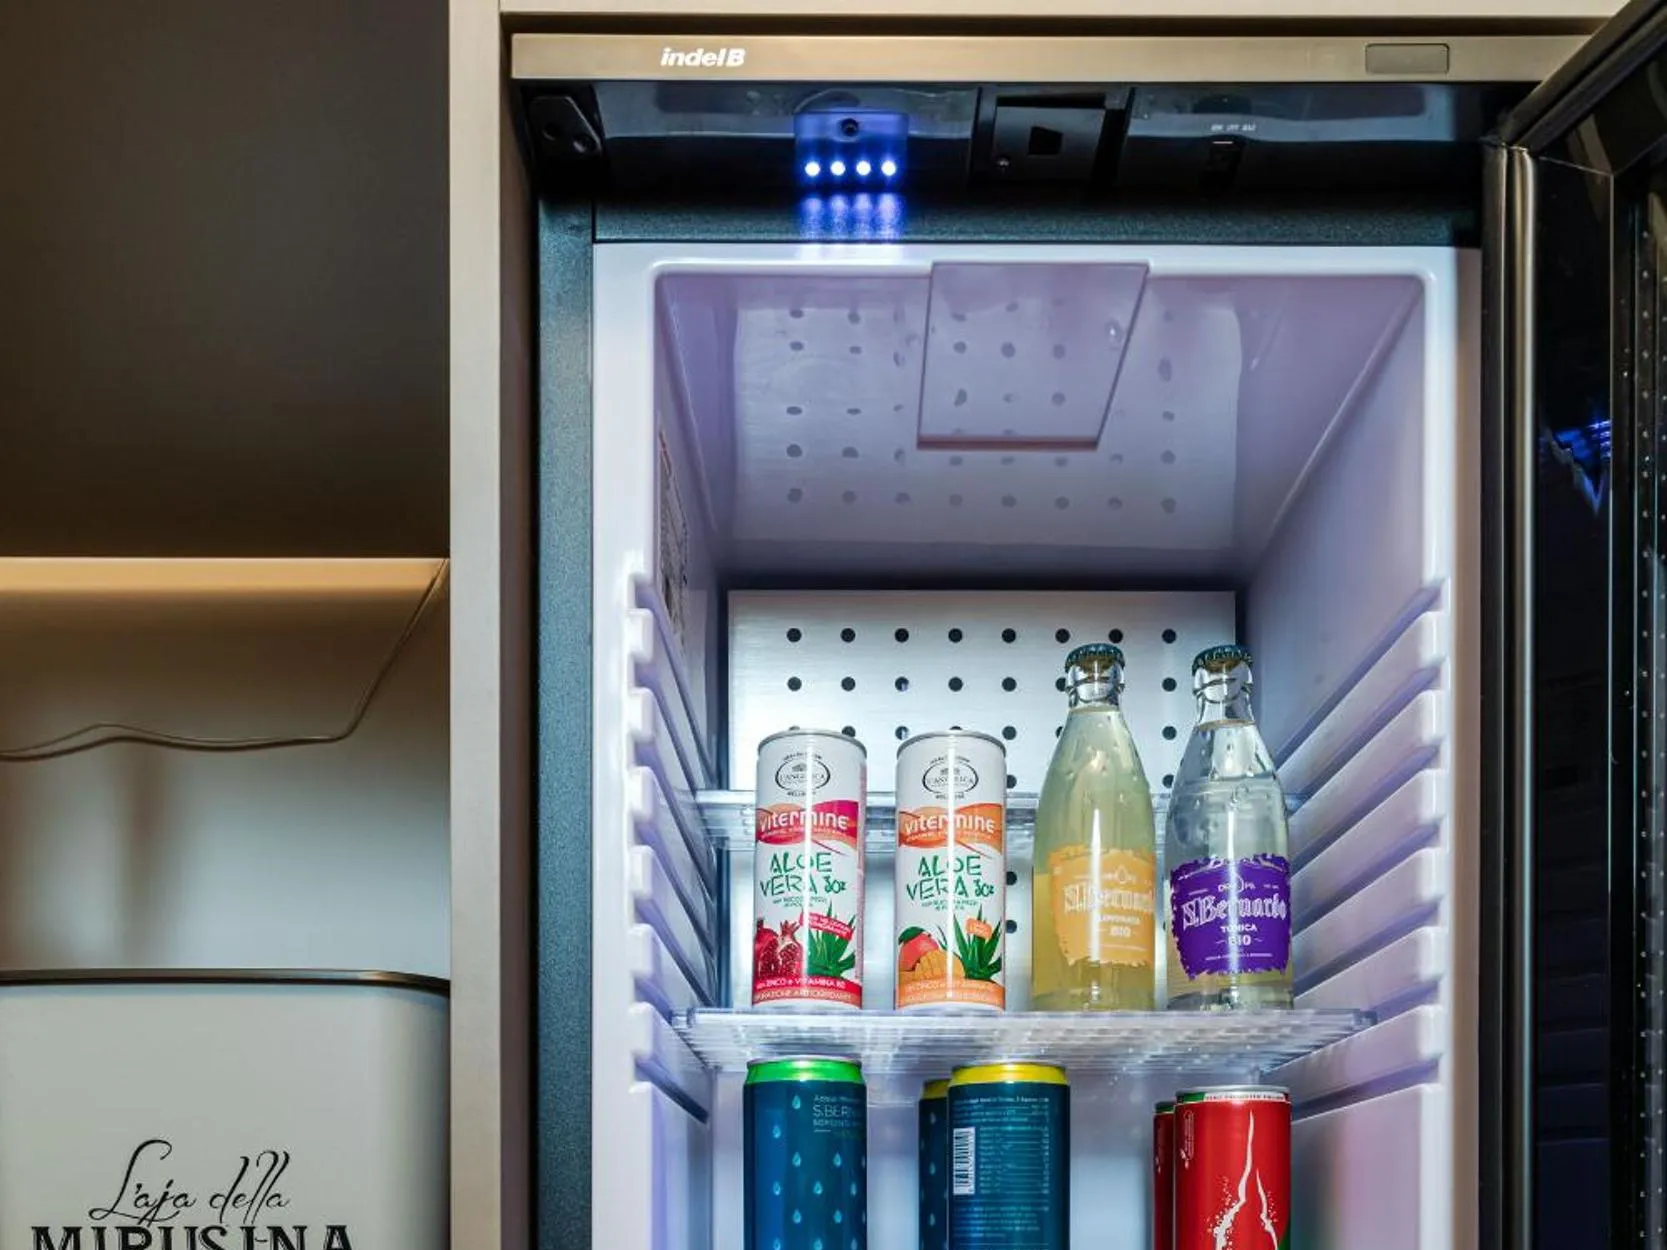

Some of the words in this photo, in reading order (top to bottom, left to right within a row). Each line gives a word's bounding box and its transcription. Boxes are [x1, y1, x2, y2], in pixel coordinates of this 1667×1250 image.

[769, 852, 833, 874] ALOE
[918, 855, 983, 877] ALOE
[760, 874, 818, 897] VERA
[906, 875, 969, 900] VERA
[209, 1150, 290, 1225] della
